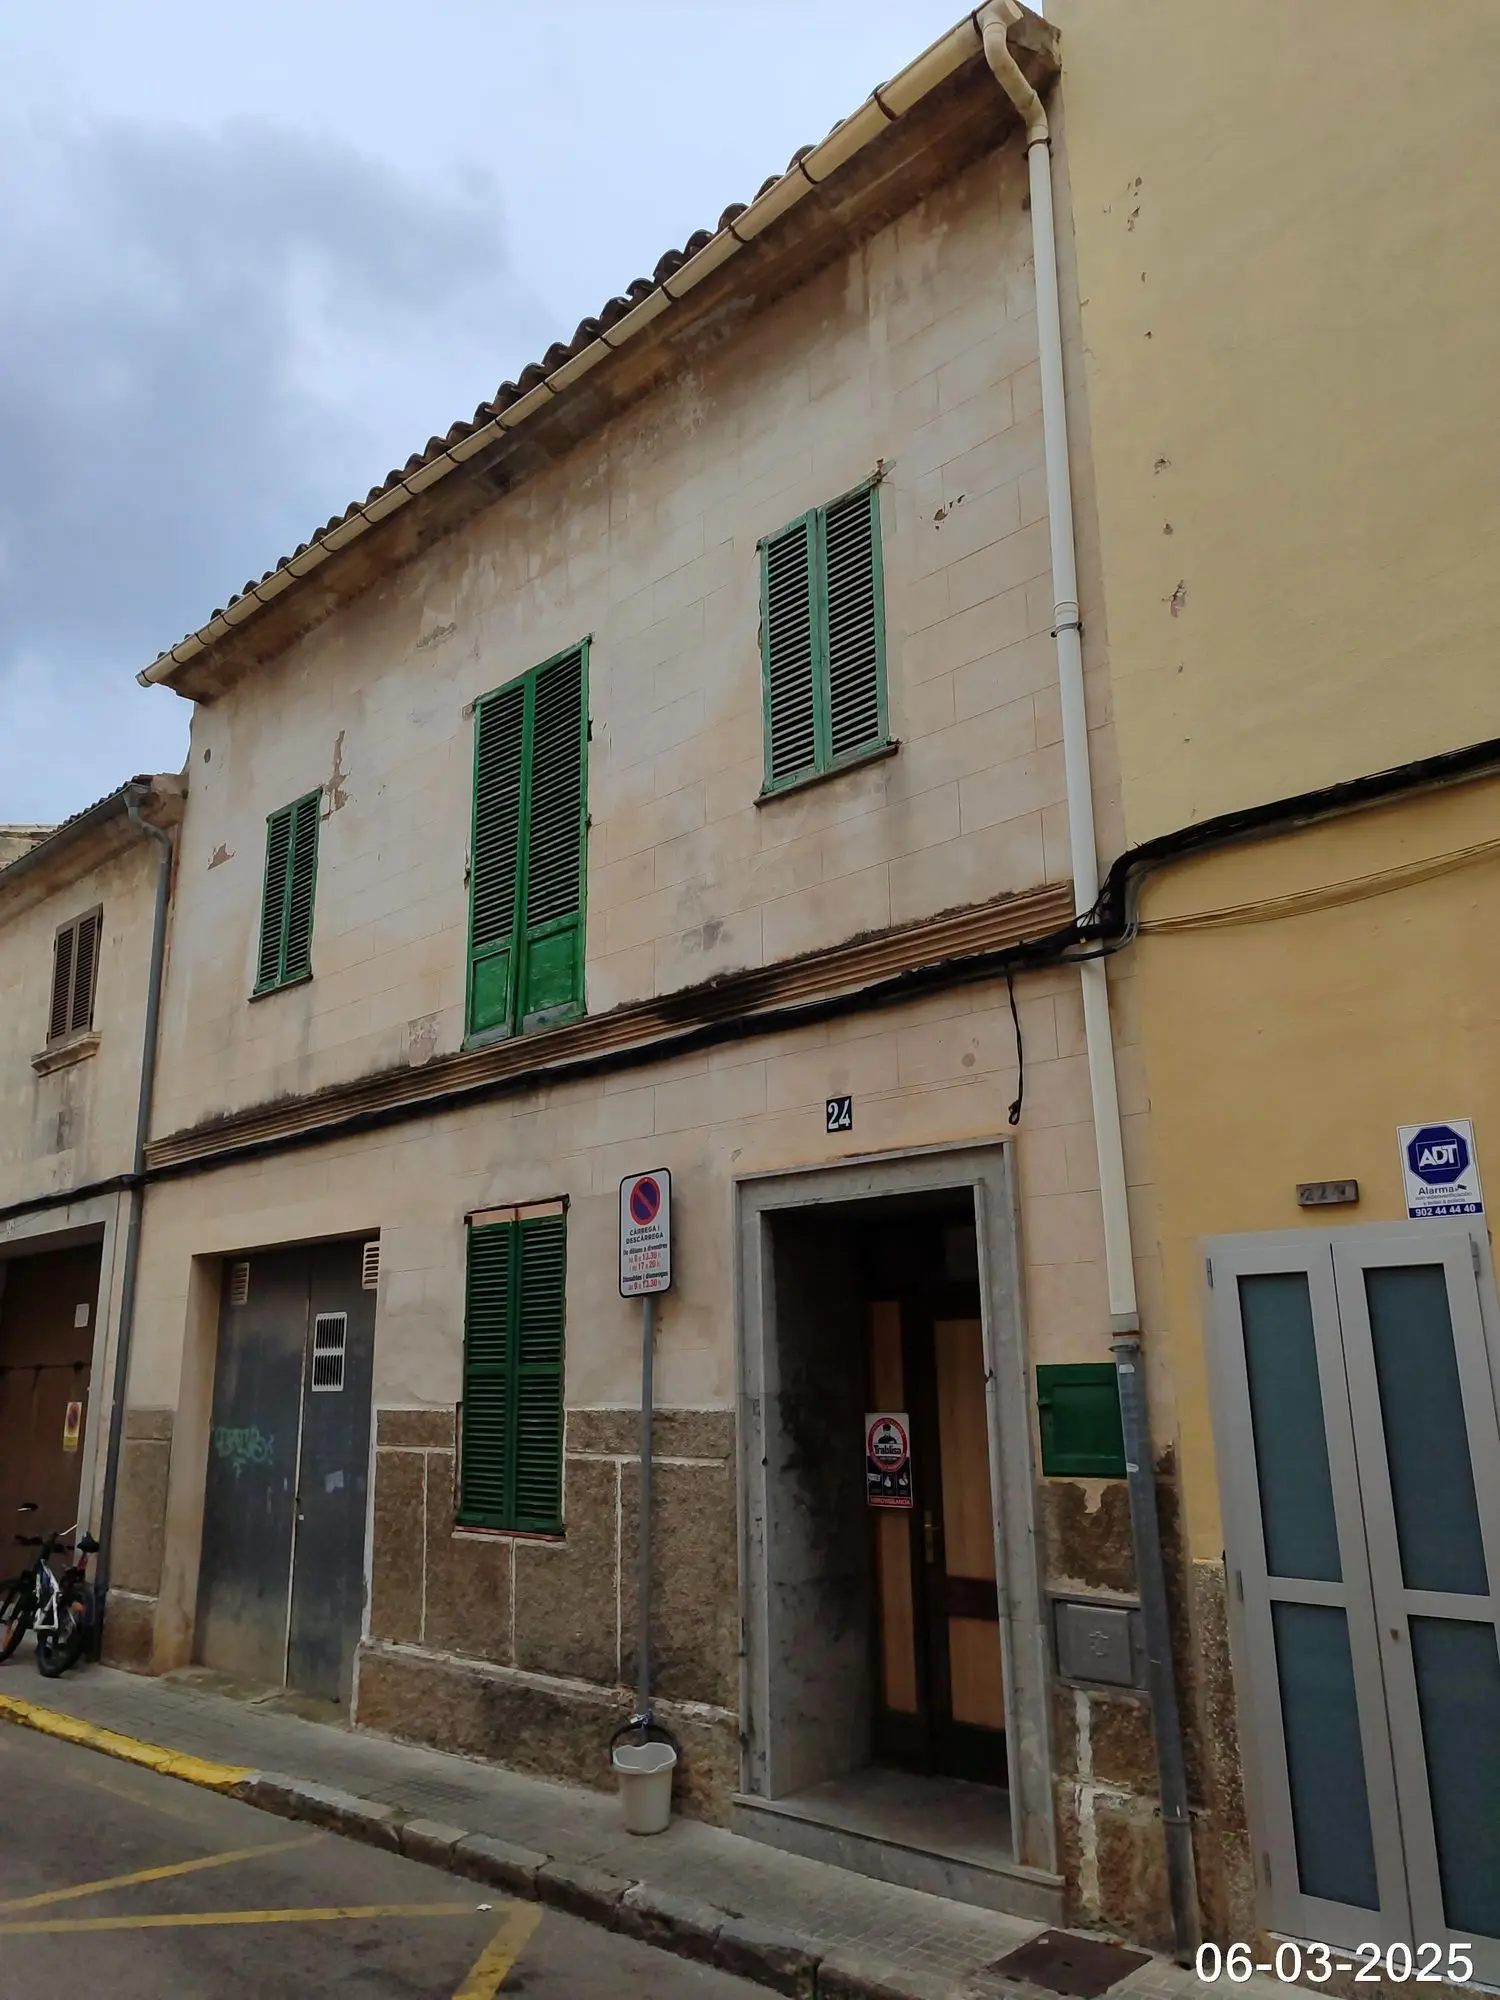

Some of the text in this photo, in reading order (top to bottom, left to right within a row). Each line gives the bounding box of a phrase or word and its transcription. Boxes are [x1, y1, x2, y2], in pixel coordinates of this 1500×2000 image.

[828, 1099, 851, 1130] 24
[1420, 1144, 1457, 1167] ADT
[1415, 1203, 1476, 1217] 902 44 44 40
